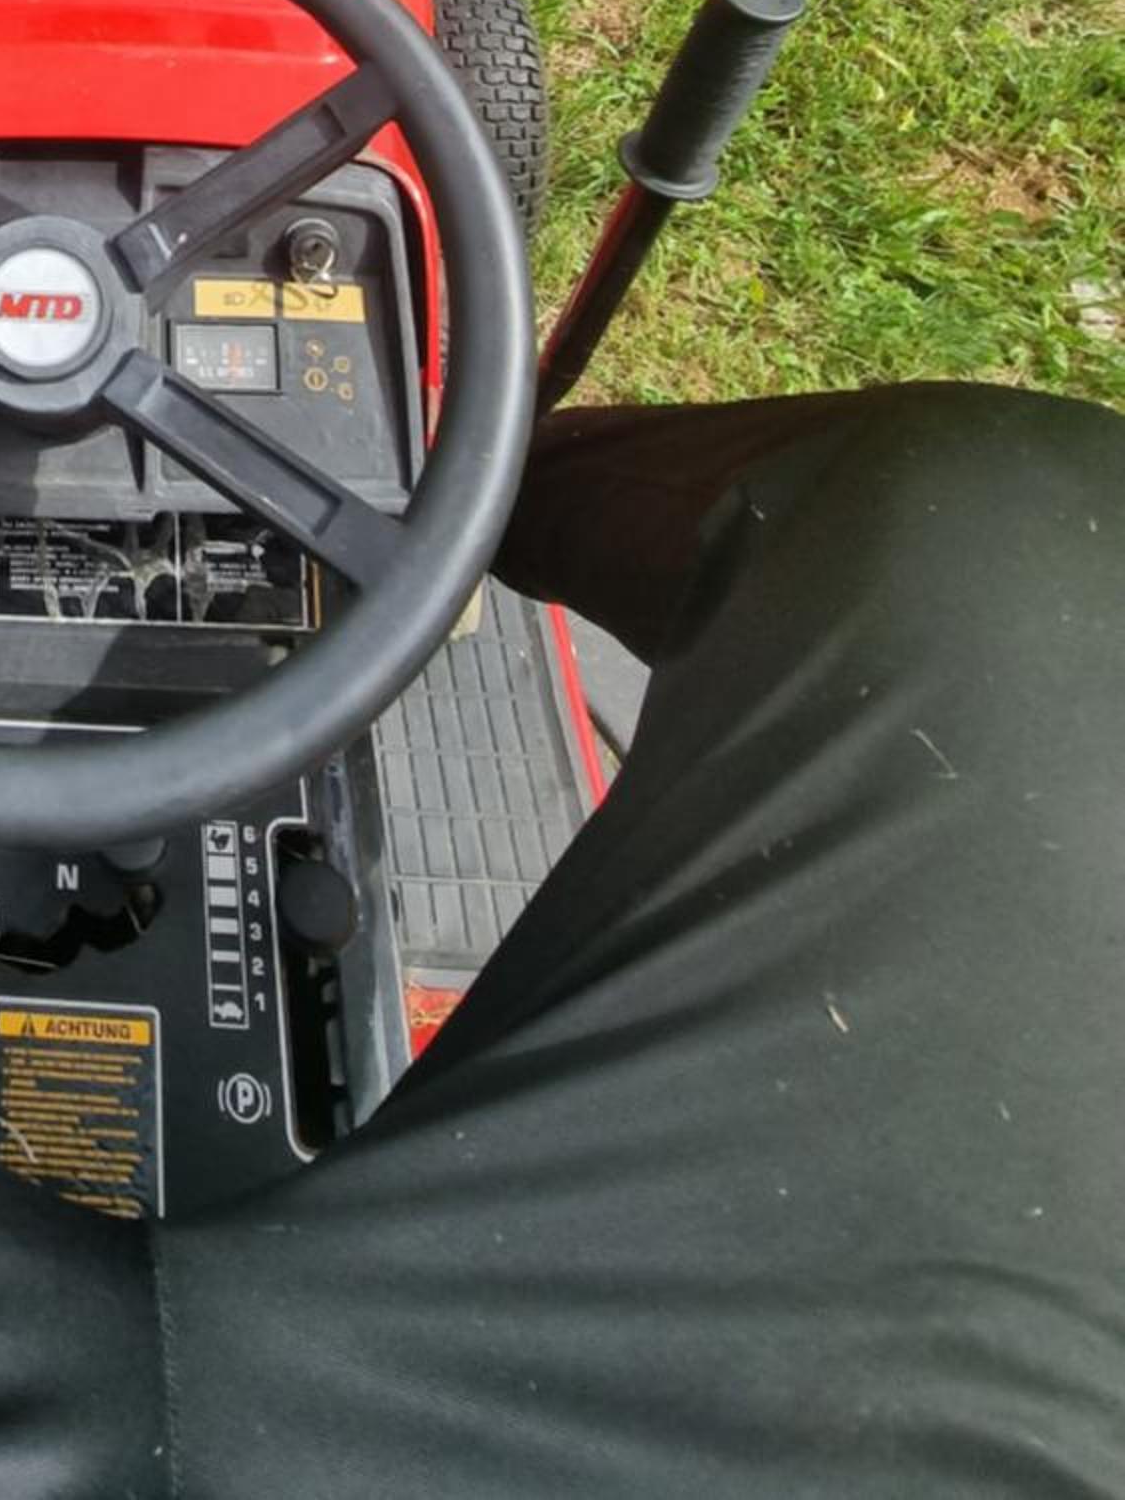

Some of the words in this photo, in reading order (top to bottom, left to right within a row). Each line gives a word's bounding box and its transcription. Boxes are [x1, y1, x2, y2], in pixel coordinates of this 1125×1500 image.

[242, 825, 256, 844] 6
[245, 856, 258, 875] 5
[56, 862, 80, 891] N
[247, 889, 261, 907] 4
[249, 922, 263, 941] 3
[251, 956, 265, 976] 2
[254, 991, 266, 1012] 1
[45, 1018, 132, 1041] ACHTUNG
[236, 1080, 255, 1114] P
